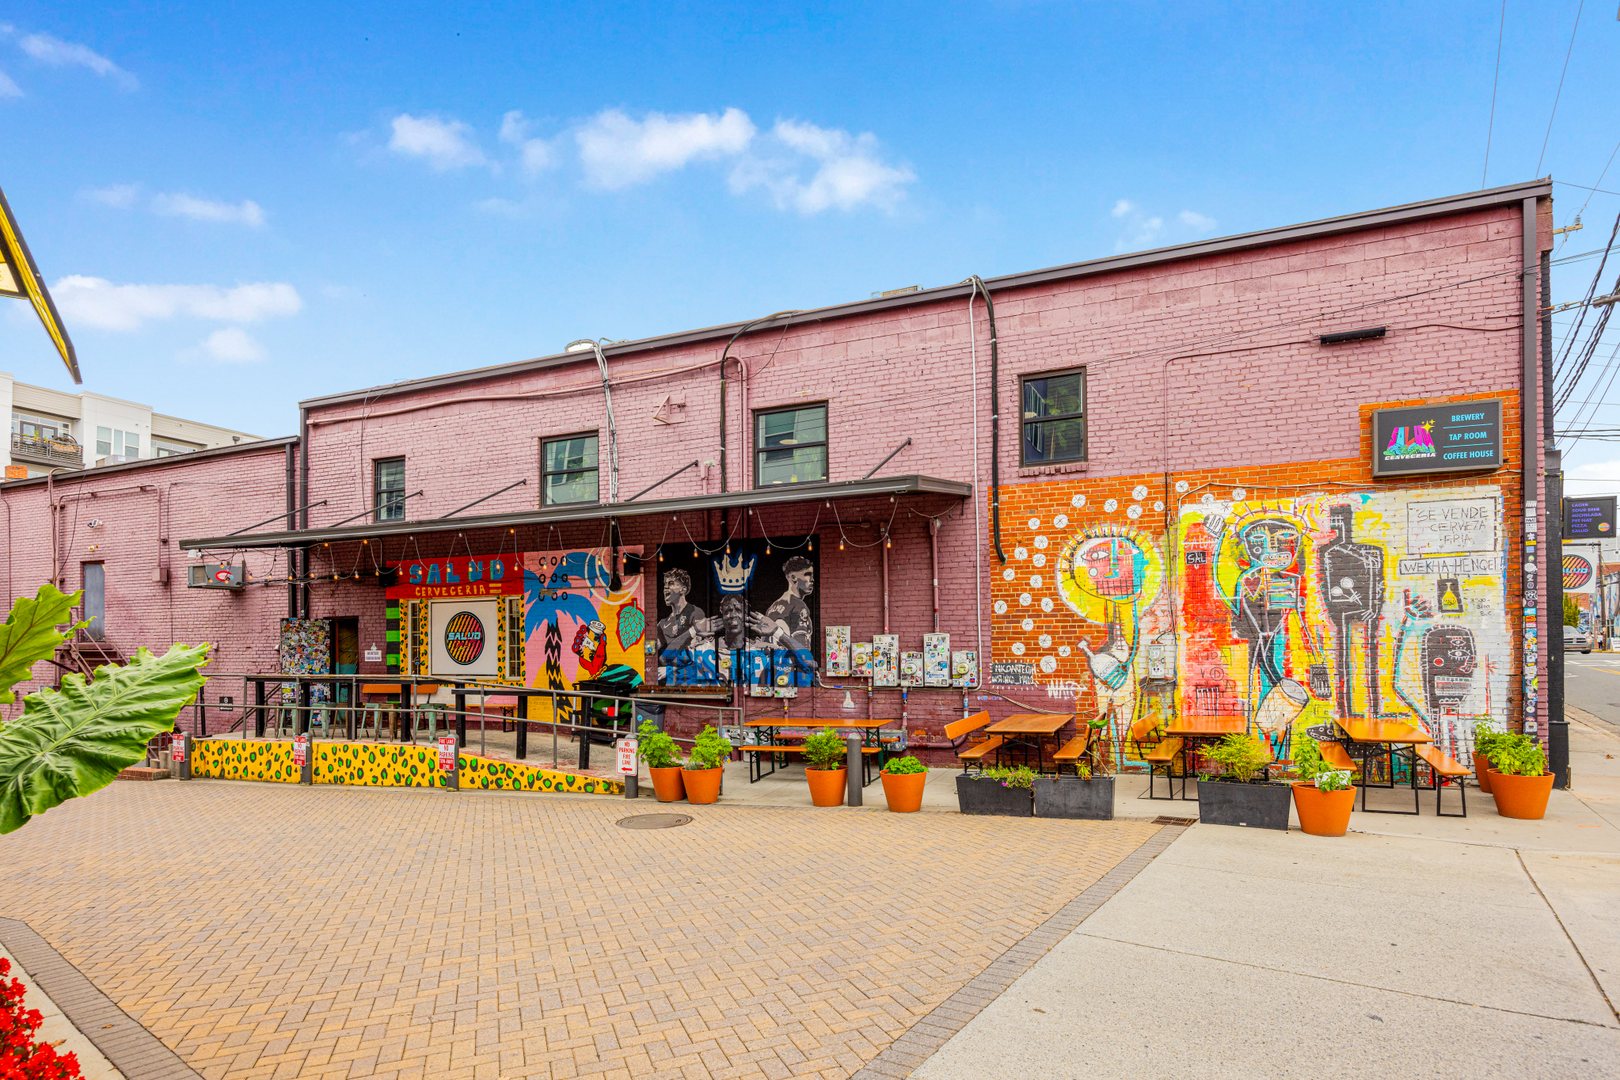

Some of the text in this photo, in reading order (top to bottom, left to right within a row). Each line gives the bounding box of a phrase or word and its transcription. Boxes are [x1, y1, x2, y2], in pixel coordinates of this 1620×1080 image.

[1451, 412, 1485, 422] BREWERY
[1449, 431, 1487, 441] TAP ROOM
[1443, 449, 1494, 460] COFFEE HOUSE
[1417, 506, 1489, 521] SE VENDE
[409, 560, 504, 584] SALUD
[415, 584, 486, 596] CERVECERIA
[447, 631, 481, 641] SALUD
